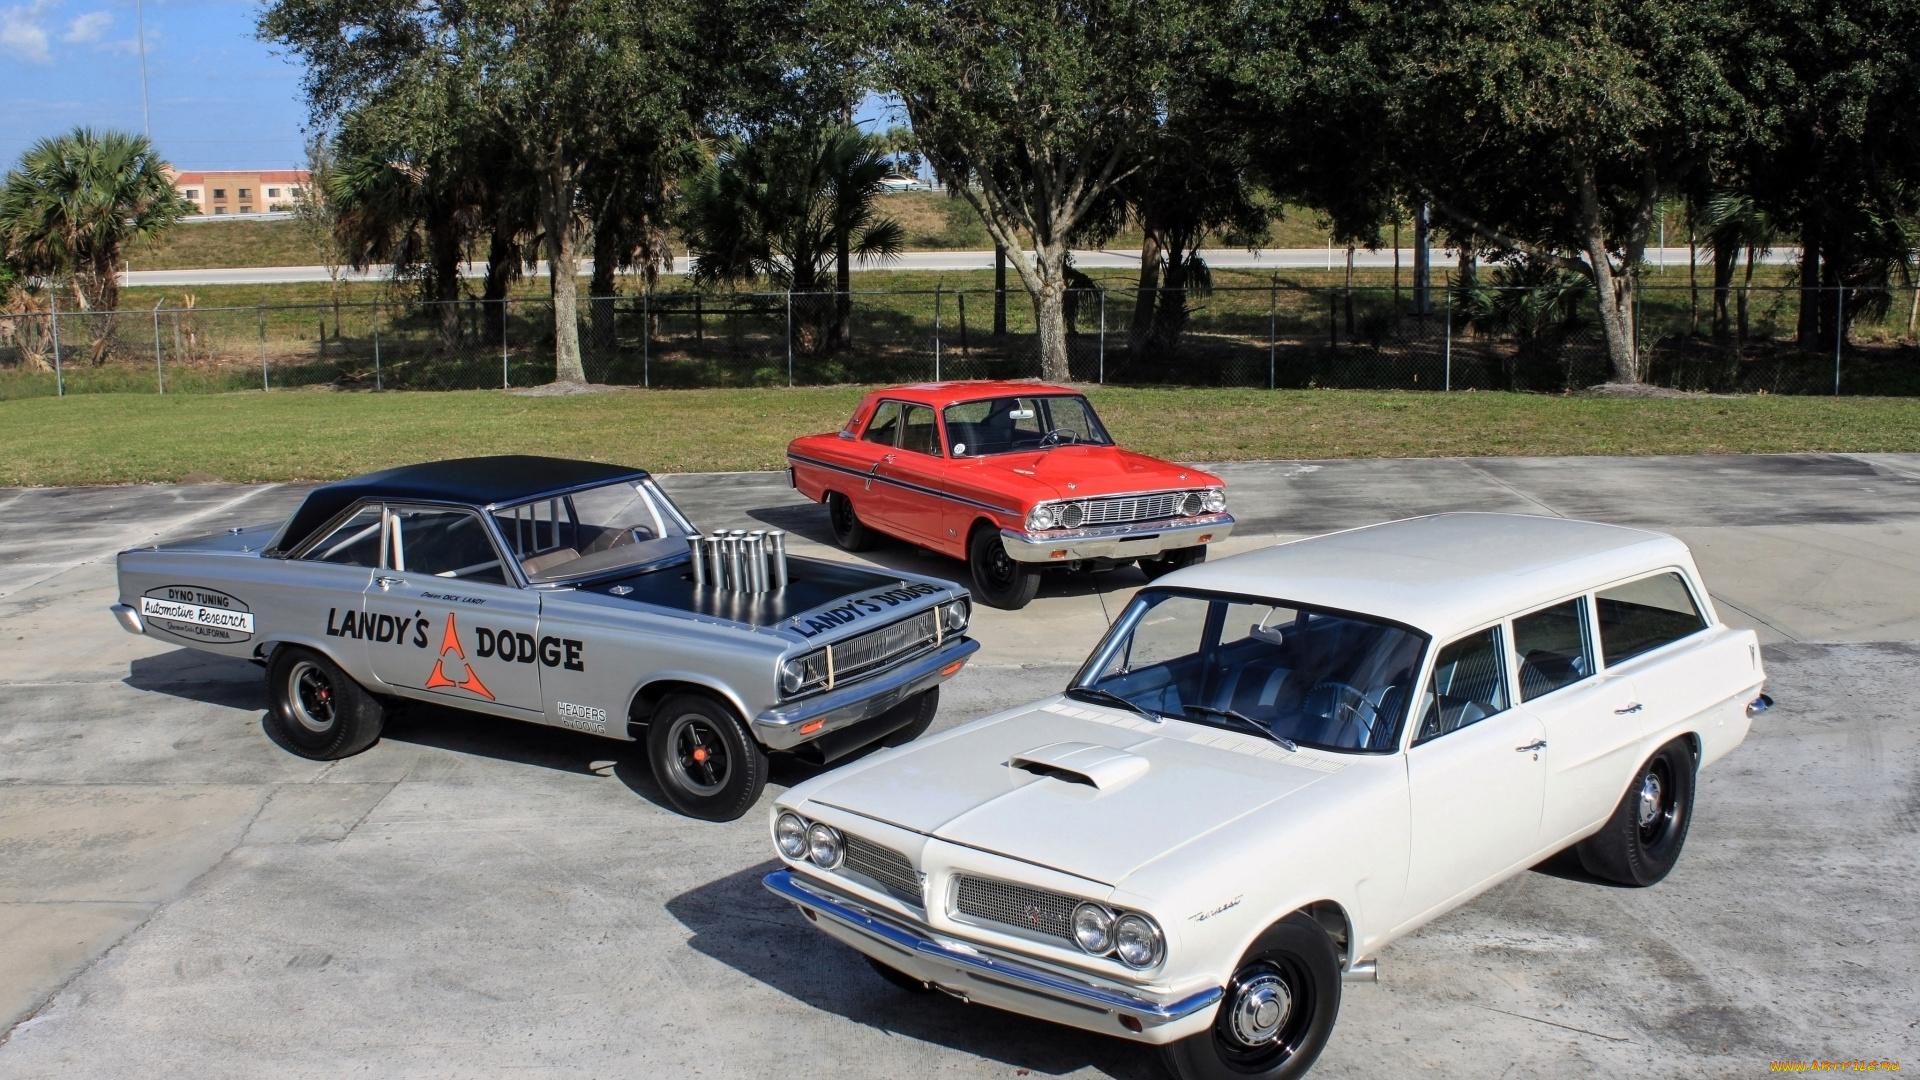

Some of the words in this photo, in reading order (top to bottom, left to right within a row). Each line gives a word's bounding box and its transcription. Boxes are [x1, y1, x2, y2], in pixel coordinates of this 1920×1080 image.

[169, 588, 194, 602] DYNO
[197, 593, 230, 607] TUNING
[442, 594, 460, 602] DICK
[462, 596, 487, 605] LANDY
[144, 600, 194, 620] Automotive
[198, 608, 247, 629] Research
[790, 599, 882, 639] LANDY'S
[870, 582, 946, 608] DODGE
[195, 626, 231, 639] CALIFORNIA
[326, 608, 430, 649] LANDY'S
[476, 626, 585, 672] DODGE
[557, 701, 606, 723] HEADERS
[574, 719, 606, 734] DOUG
